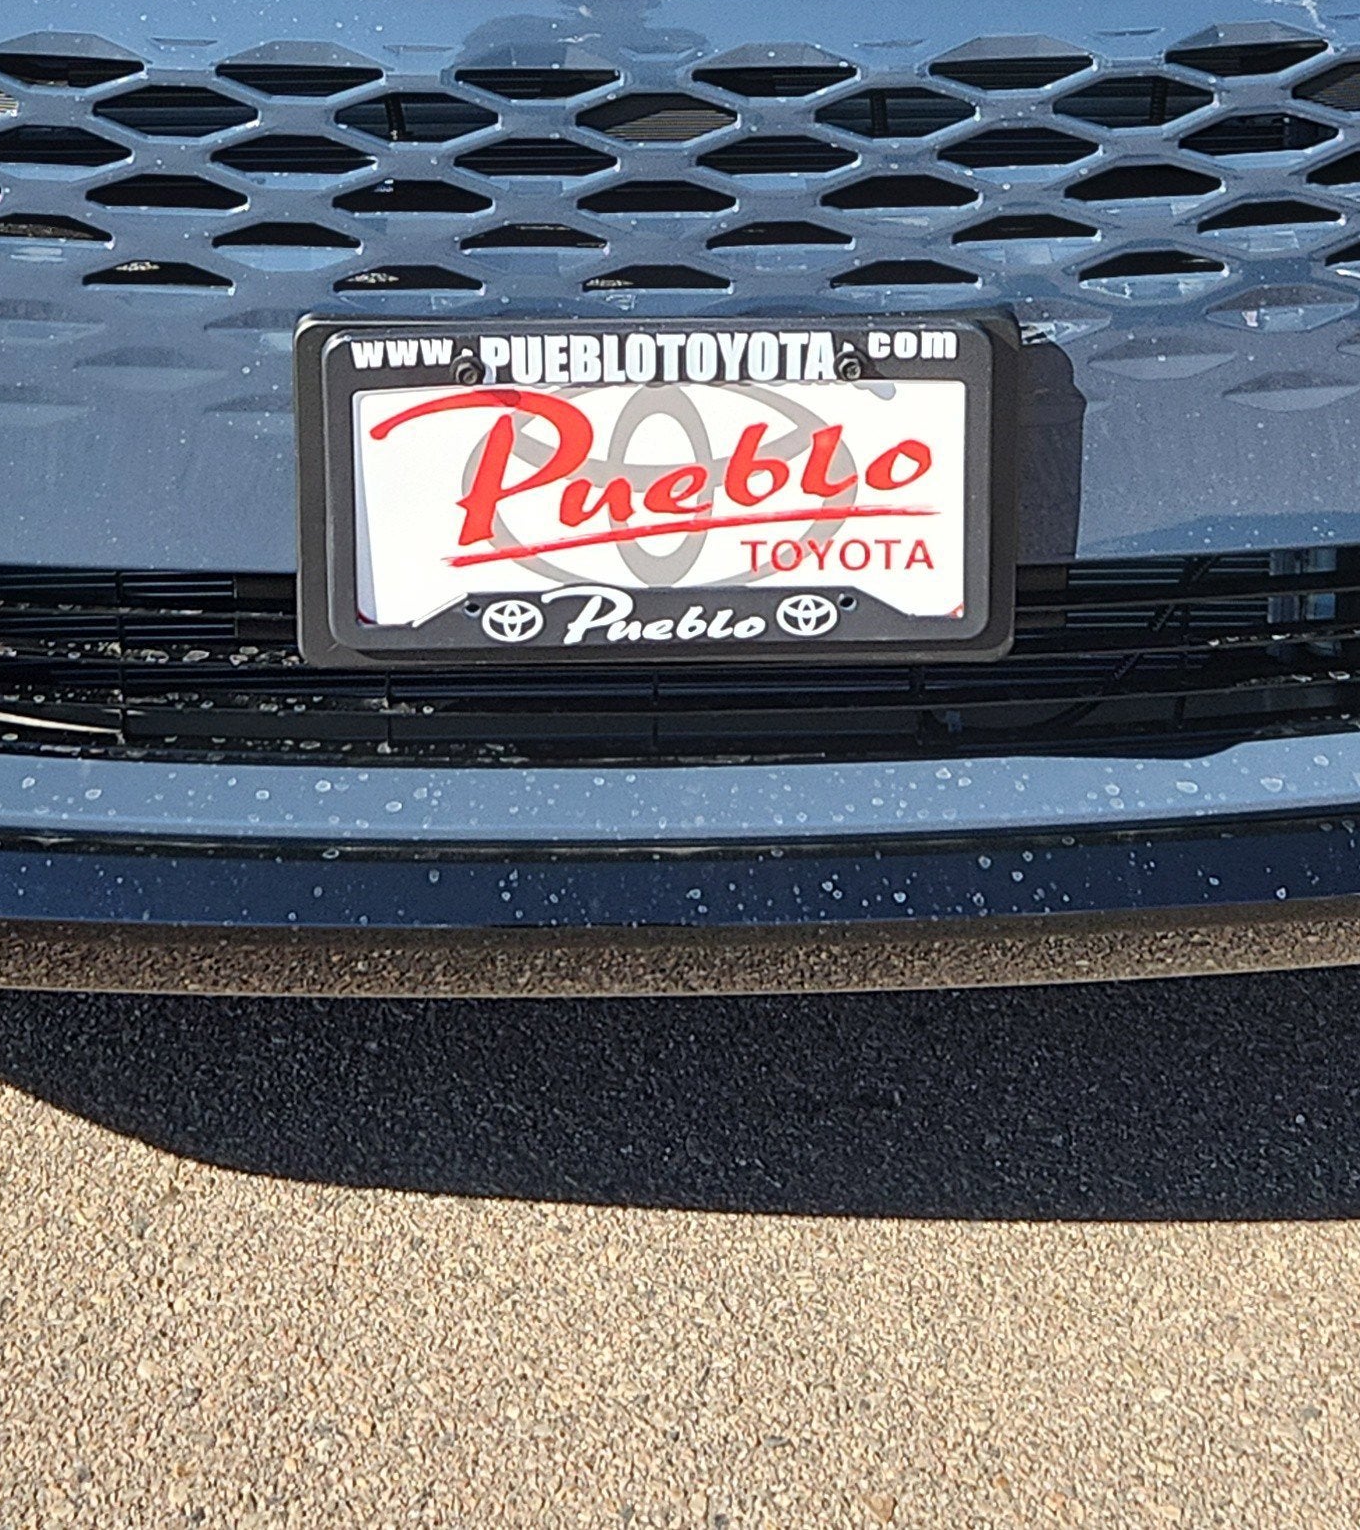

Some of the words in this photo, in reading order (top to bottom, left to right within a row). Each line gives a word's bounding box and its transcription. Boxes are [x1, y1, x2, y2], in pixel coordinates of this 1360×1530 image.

[370, 389, 933, 545] Pueblo
[740, 539, 934, 571] TOYOTA
[541, 585, 766, 645] Pueblo
